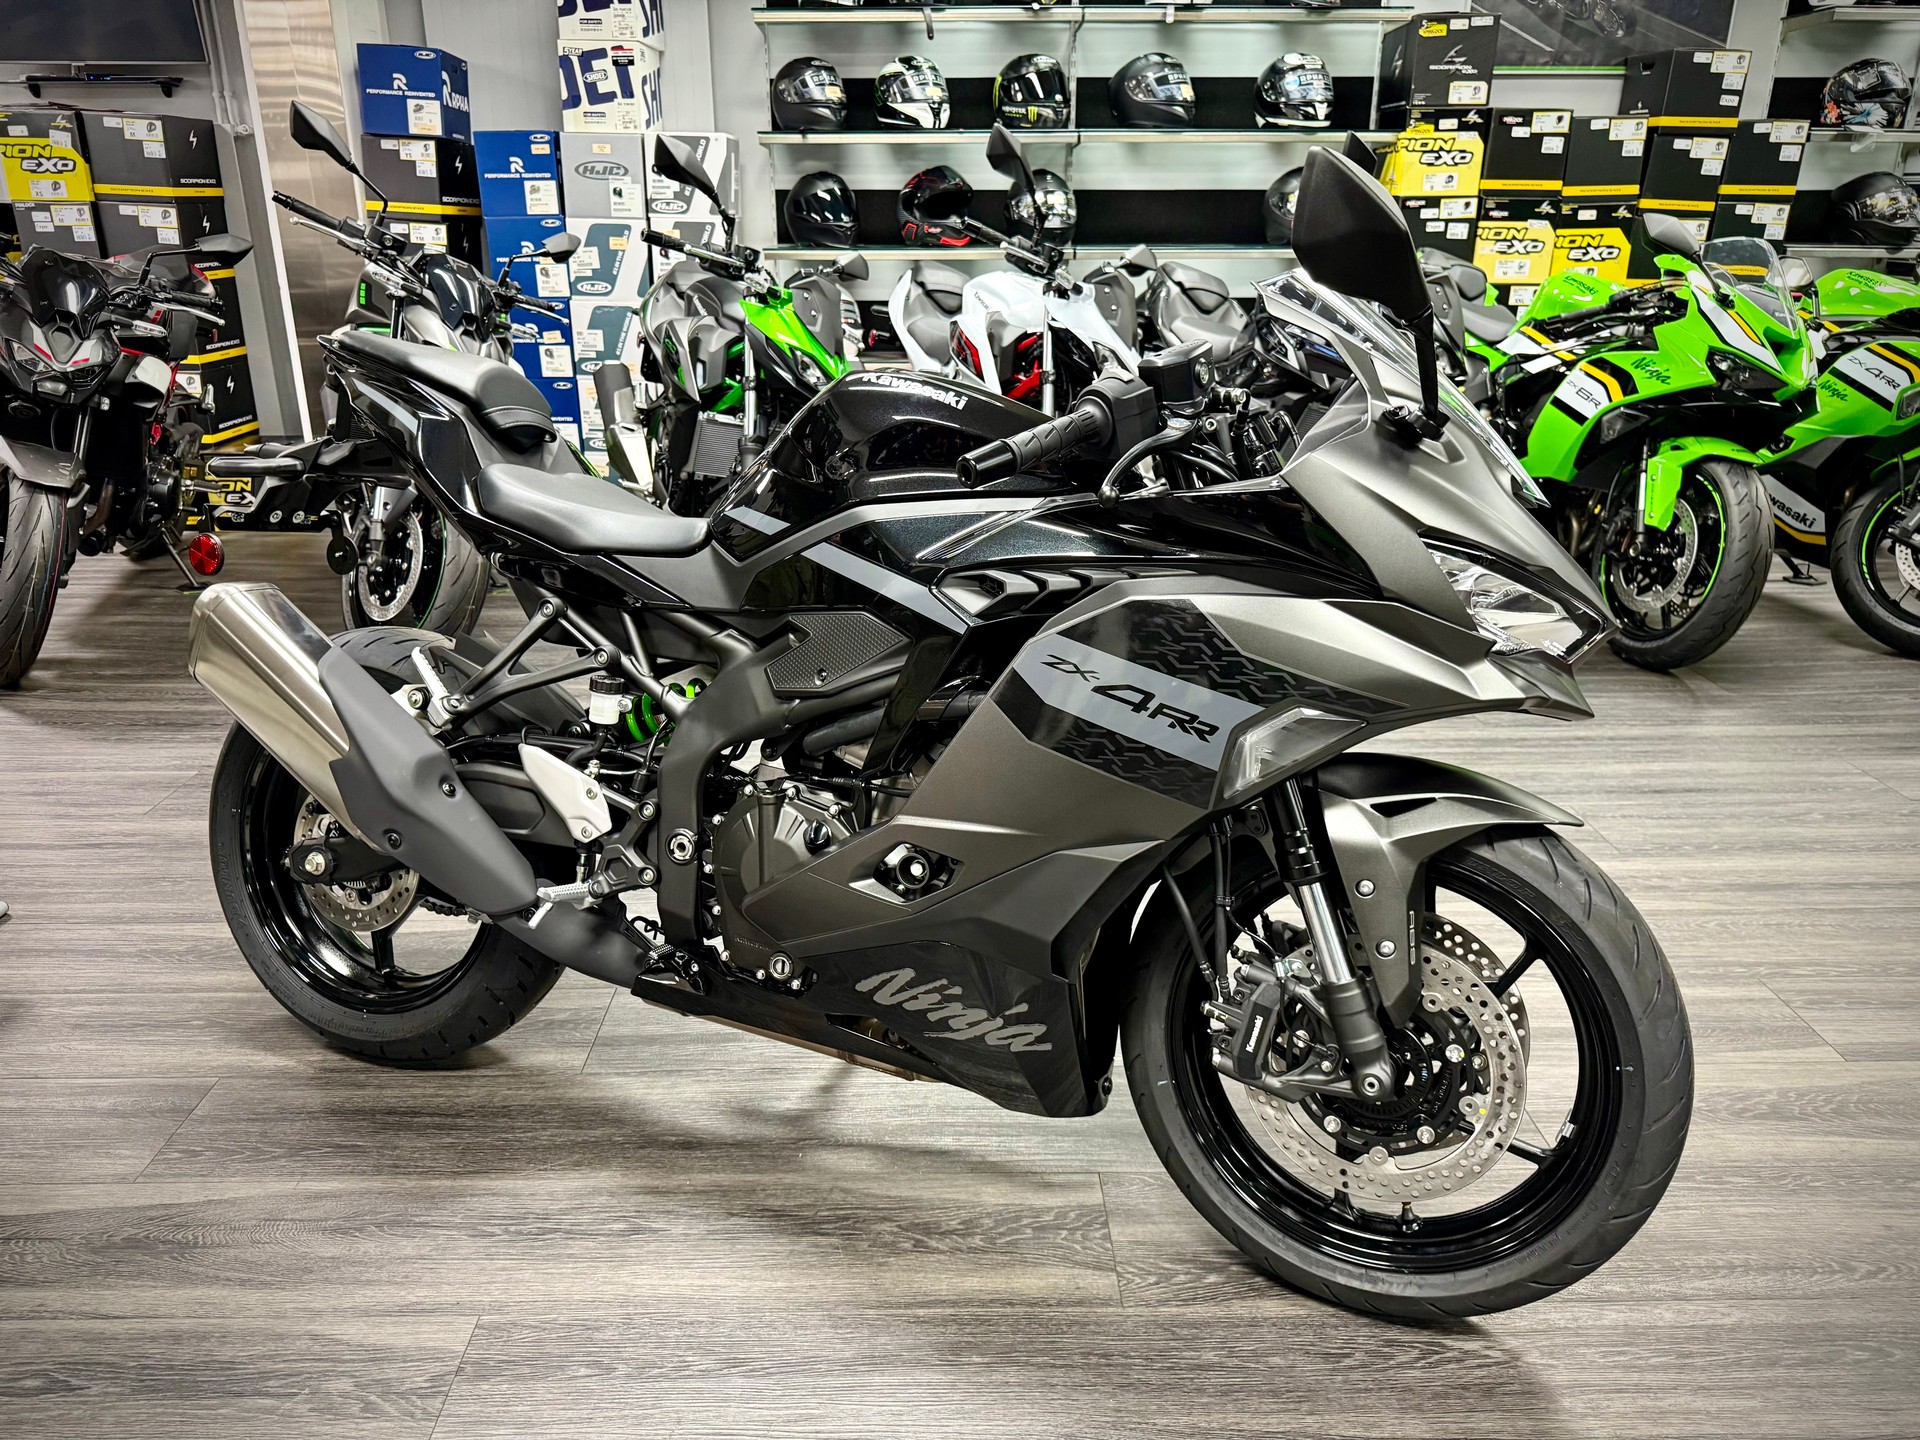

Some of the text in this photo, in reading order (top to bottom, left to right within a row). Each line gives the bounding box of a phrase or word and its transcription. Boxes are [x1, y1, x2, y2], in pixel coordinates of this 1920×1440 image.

[582, 164, 621, 177] HJC
[1630, 356, 1671, 385] Ninja
[862, 372, 969, 411] Kawasaki
[1818, 379, 1849, 402] Ninja
[1769, 493, 1817, 530] wasaki
[1040, 653, 1221, 744] ZX-4RR
[854, 966, 1052, 1053] Ninja
[1245, 1014, 1264, 1053] Kawasaki
